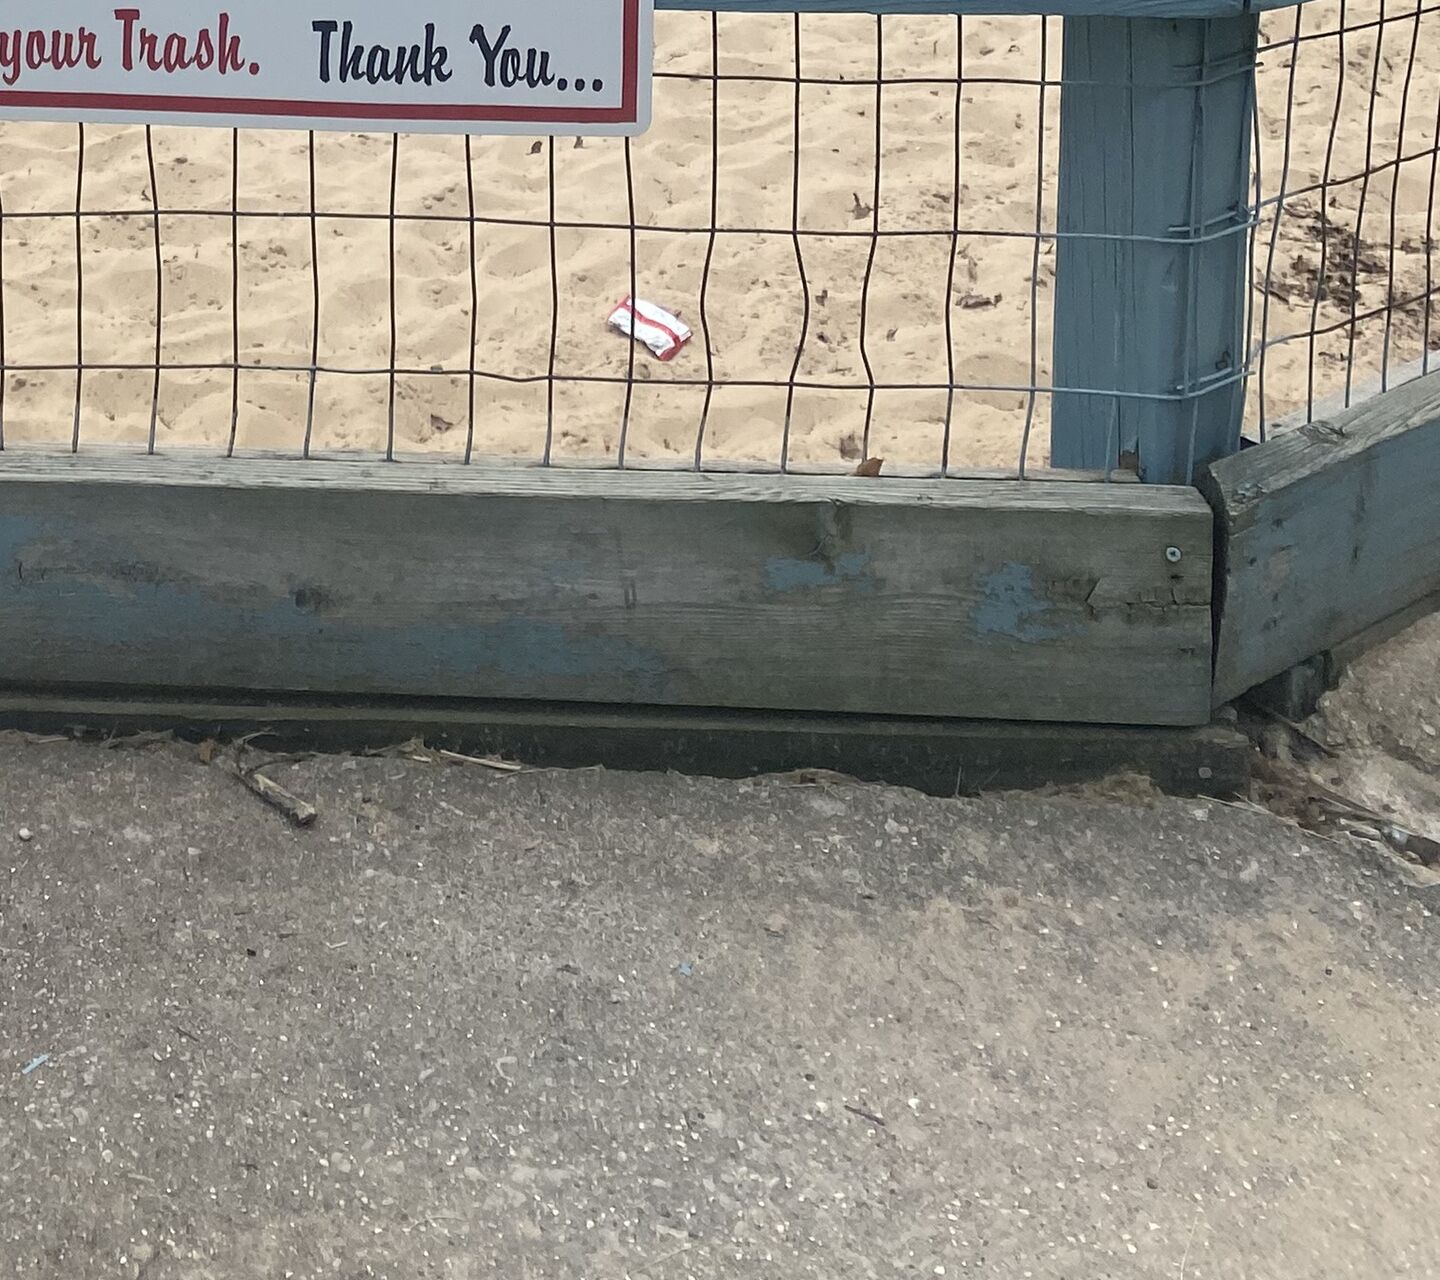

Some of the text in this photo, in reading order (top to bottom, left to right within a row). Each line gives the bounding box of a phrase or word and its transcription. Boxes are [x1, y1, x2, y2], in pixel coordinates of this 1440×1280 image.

[0, 26, 102, 86] your
[113, 8, 260, 76] Trash.
[311, 20, 604, 93] Thank You...
